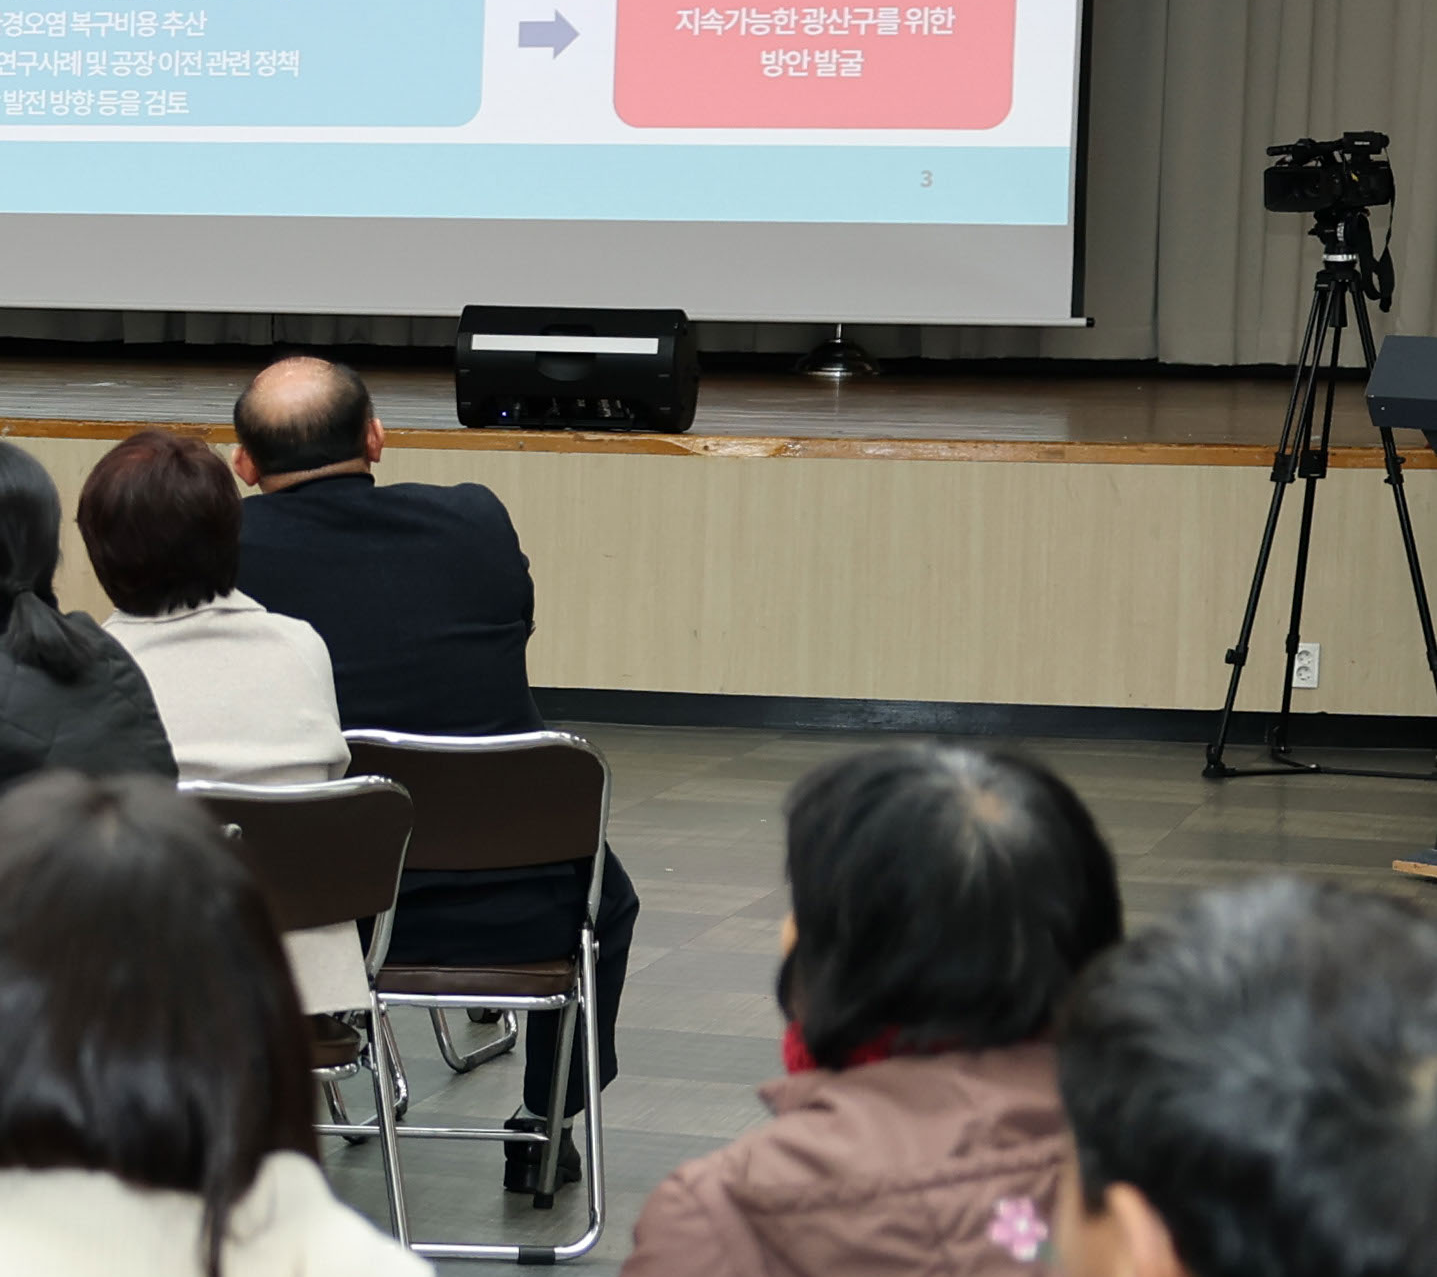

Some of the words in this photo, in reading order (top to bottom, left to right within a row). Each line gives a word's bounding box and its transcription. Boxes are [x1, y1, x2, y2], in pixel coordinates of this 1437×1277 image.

[69, 9, 159, 38] 복구비용
[160, 9, 208, 37] 추산
[675, 6, 799, 36] 지속가능한
[799, 6, 901, 36] 광산구를
[903, 6, 956, 35] 위한
[85, 49, 107, 77] 및
[109, 49, 156, 77] 공장
[157, 49, 202, 77] 이전
[205, 49, 251, 76] 관련
[253, 49, 299, 77] 정책
[760, 48, 812, 77] 방안
[813, 48, 864, 77] 발굴
[2, 89, 46, 116] 발전
[49, 88, 95, 116] 방향
[96, 89, 142, 117] 등을
[143, 89, 190, 116] 검토
[919, 169, 933, 188] 3
